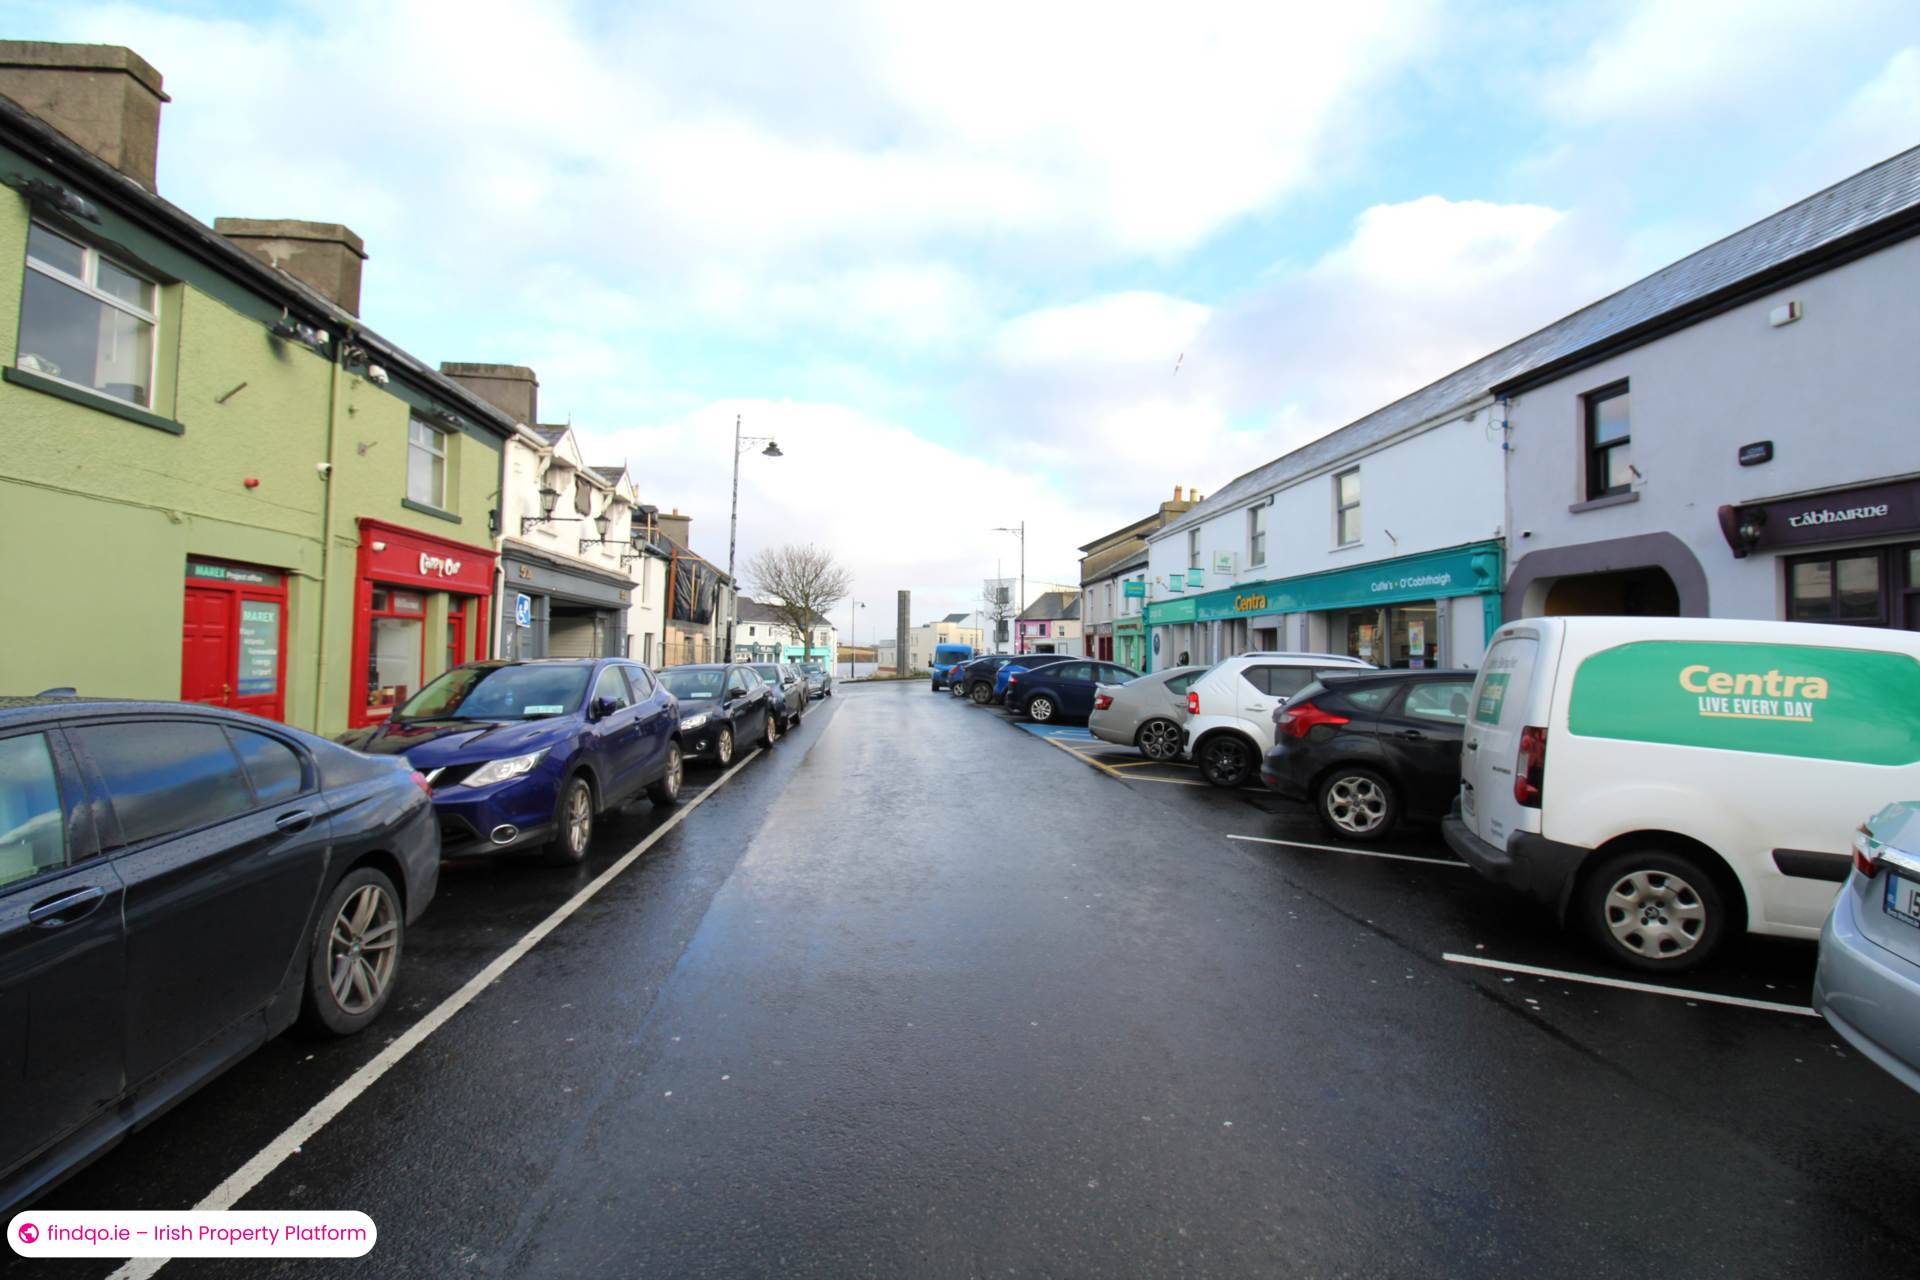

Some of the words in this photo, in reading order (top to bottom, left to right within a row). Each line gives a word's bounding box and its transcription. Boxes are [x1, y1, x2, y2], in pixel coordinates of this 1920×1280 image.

[1234, 594, 1267, 611] Centra
[1680, 664, 1828, 699] Centra
[1698, 696, 1729, 713] LIVE
[1734, 698, 1779, 715] EVERY
[1784, 701, 1813, 717] DAY
